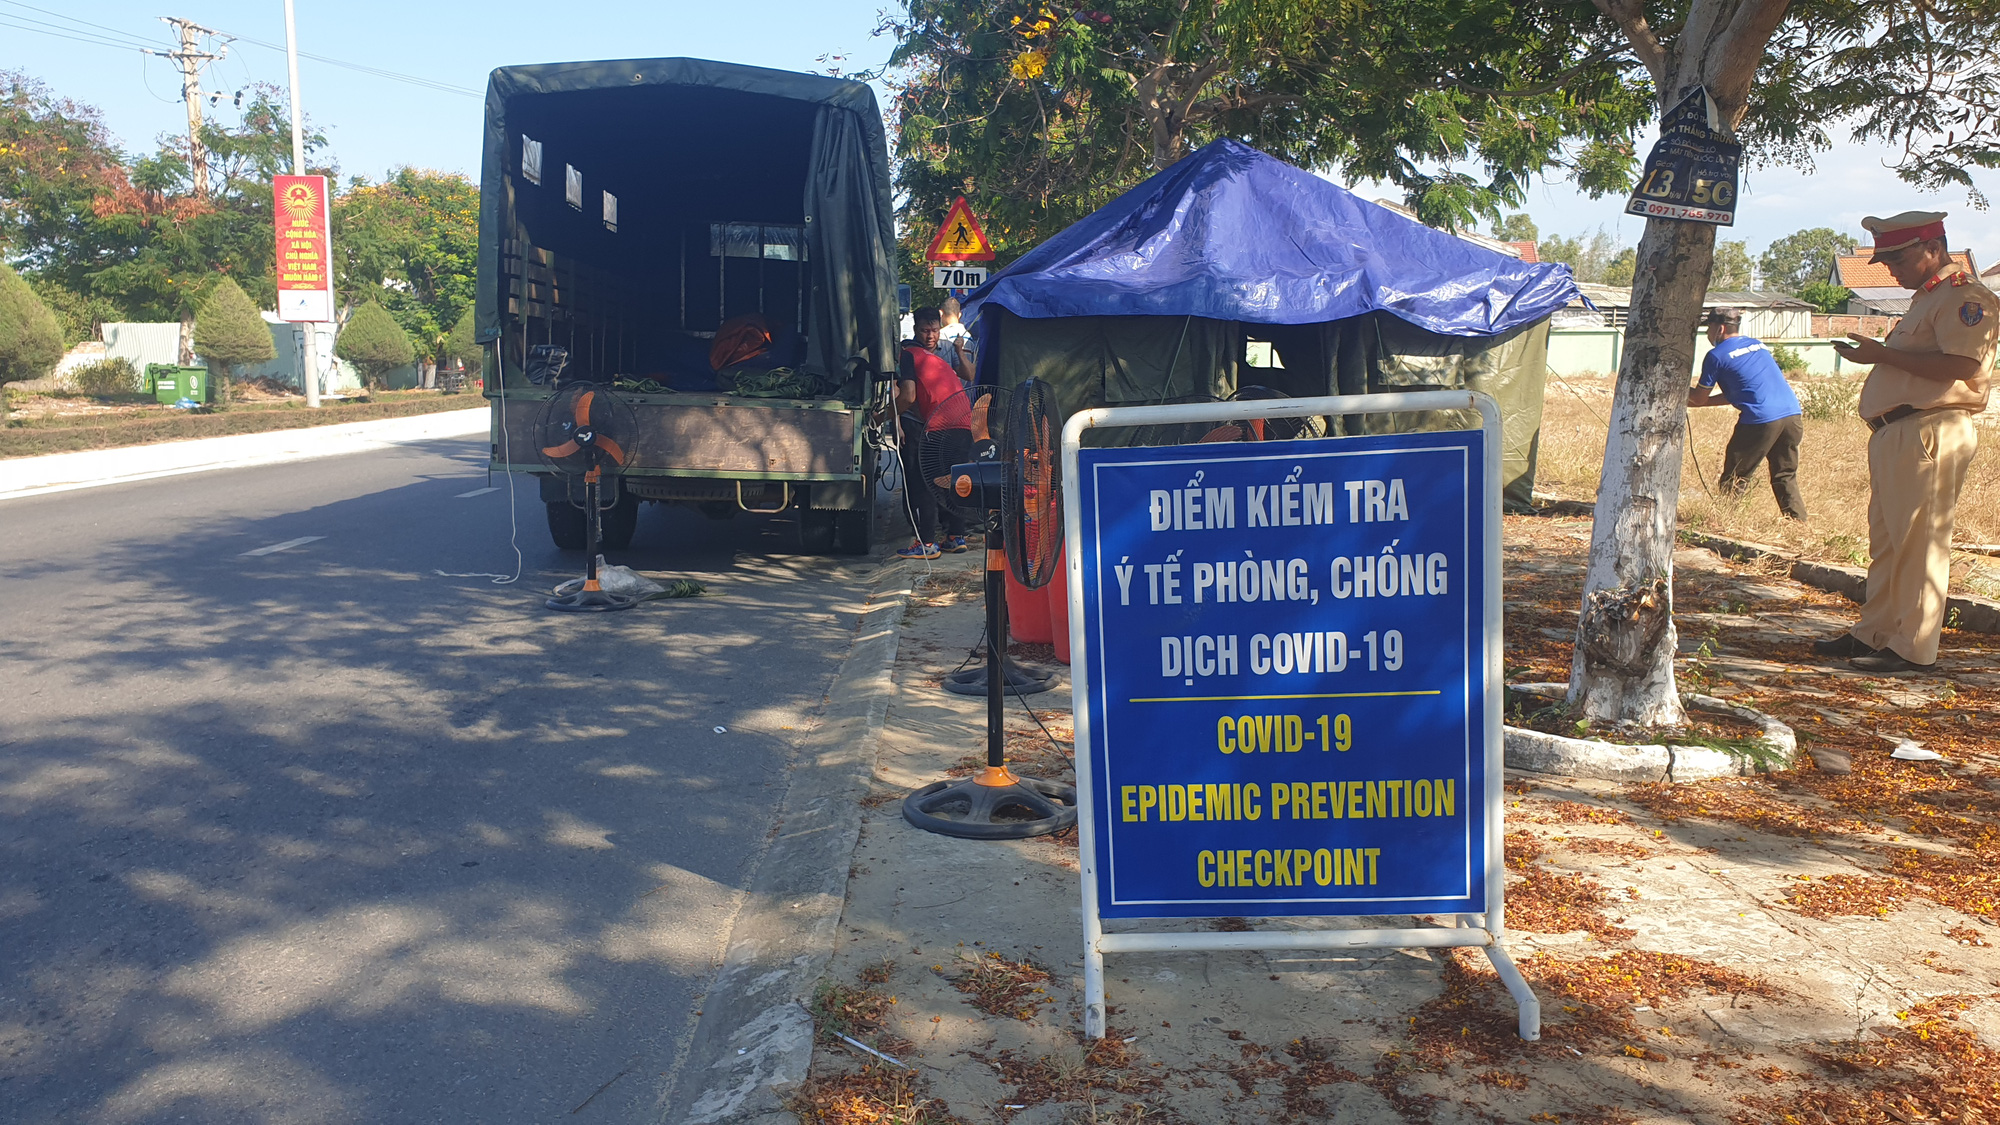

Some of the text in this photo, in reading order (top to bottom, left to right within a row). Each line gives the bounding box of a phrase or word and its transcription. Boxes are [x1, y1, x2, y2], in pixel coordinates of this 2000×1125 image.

[1699, 115, 1707, 124] TH
[941, 269, 980, 286] 70m
[1149, 465, 1409, 531] ĐIỂM KIỂM TRA
[1114, 539, 1448, 605] Ý TẾ PHÒNG, CHỐNG
[1161, 629, 1403, 686] DỊCH COVID-19
[1217, 713, 1352, 754] COVID-19
[1121, 778, 1455, 822] EPIDEMIC PREVENTION
[1197, 848, 1381, 888] CHECKPOINT
